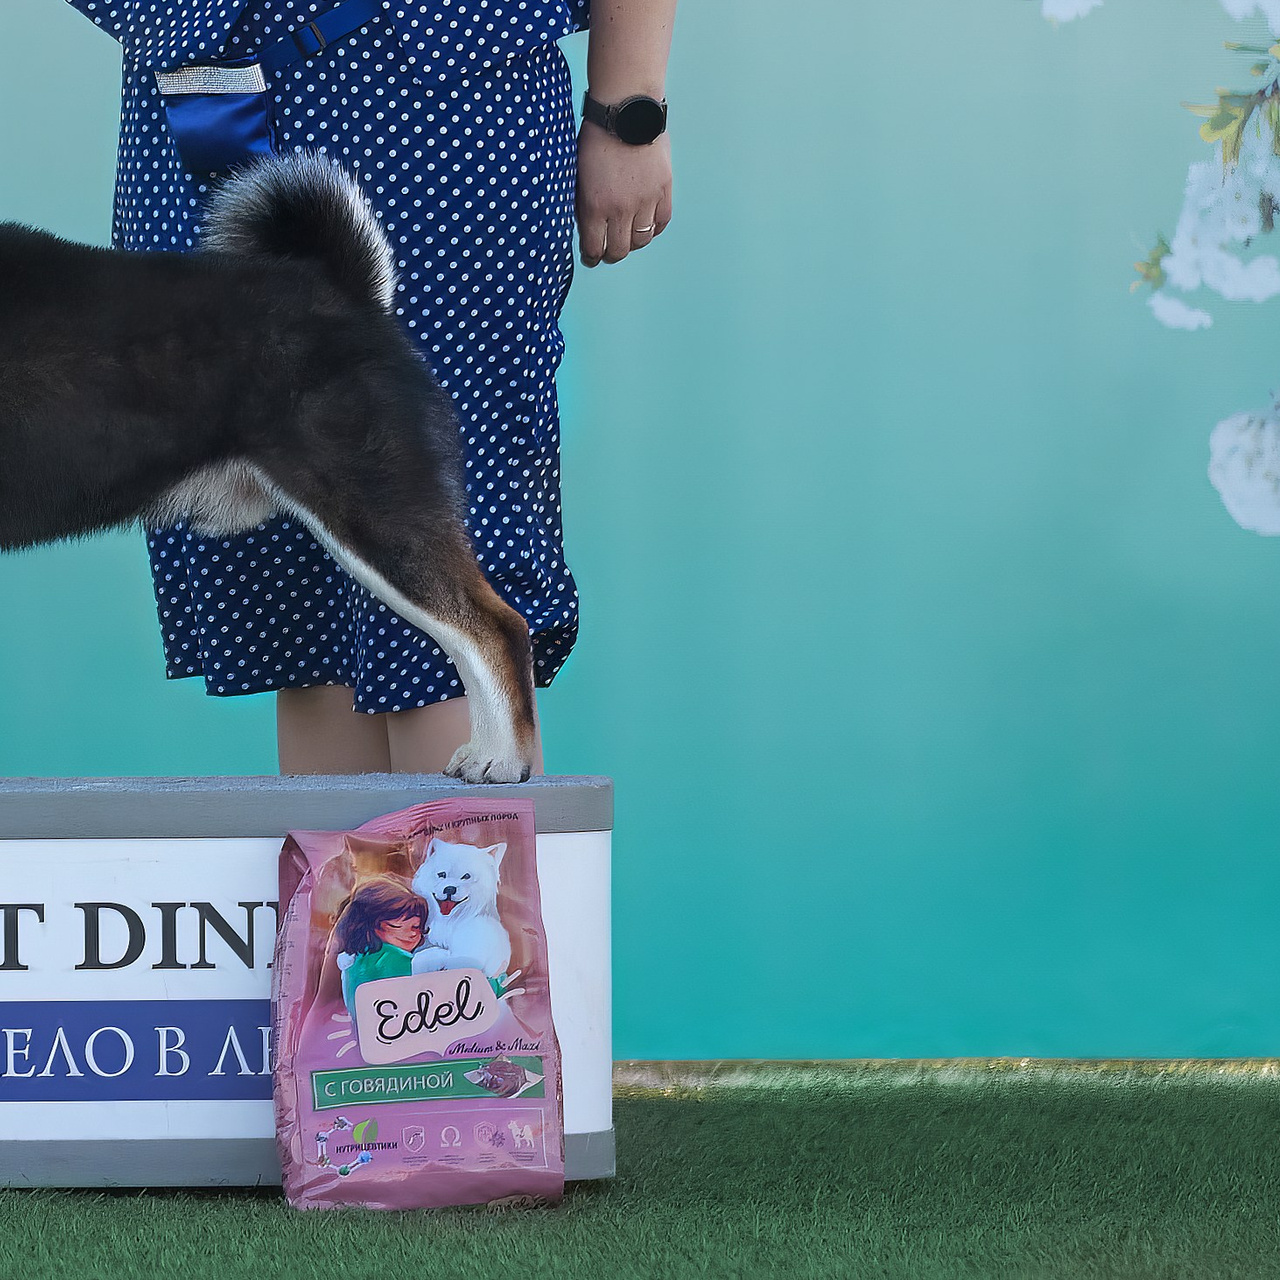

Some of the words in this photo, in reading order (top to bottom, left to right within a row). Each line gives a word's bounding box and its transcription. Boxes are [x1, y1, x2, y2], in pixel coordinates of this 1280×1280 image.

[73, 901, 279, 970] DIN
[375, 978, 483, 1041] Edel
[154, 1026, 190, 1077] В
[324, 1081, 336, 1097] С
[341, 1071, 454, 1096] ГОВЯДИНОЙ
[336, 1141, 398, 1154] НУТРИЦЕВТИКИ
